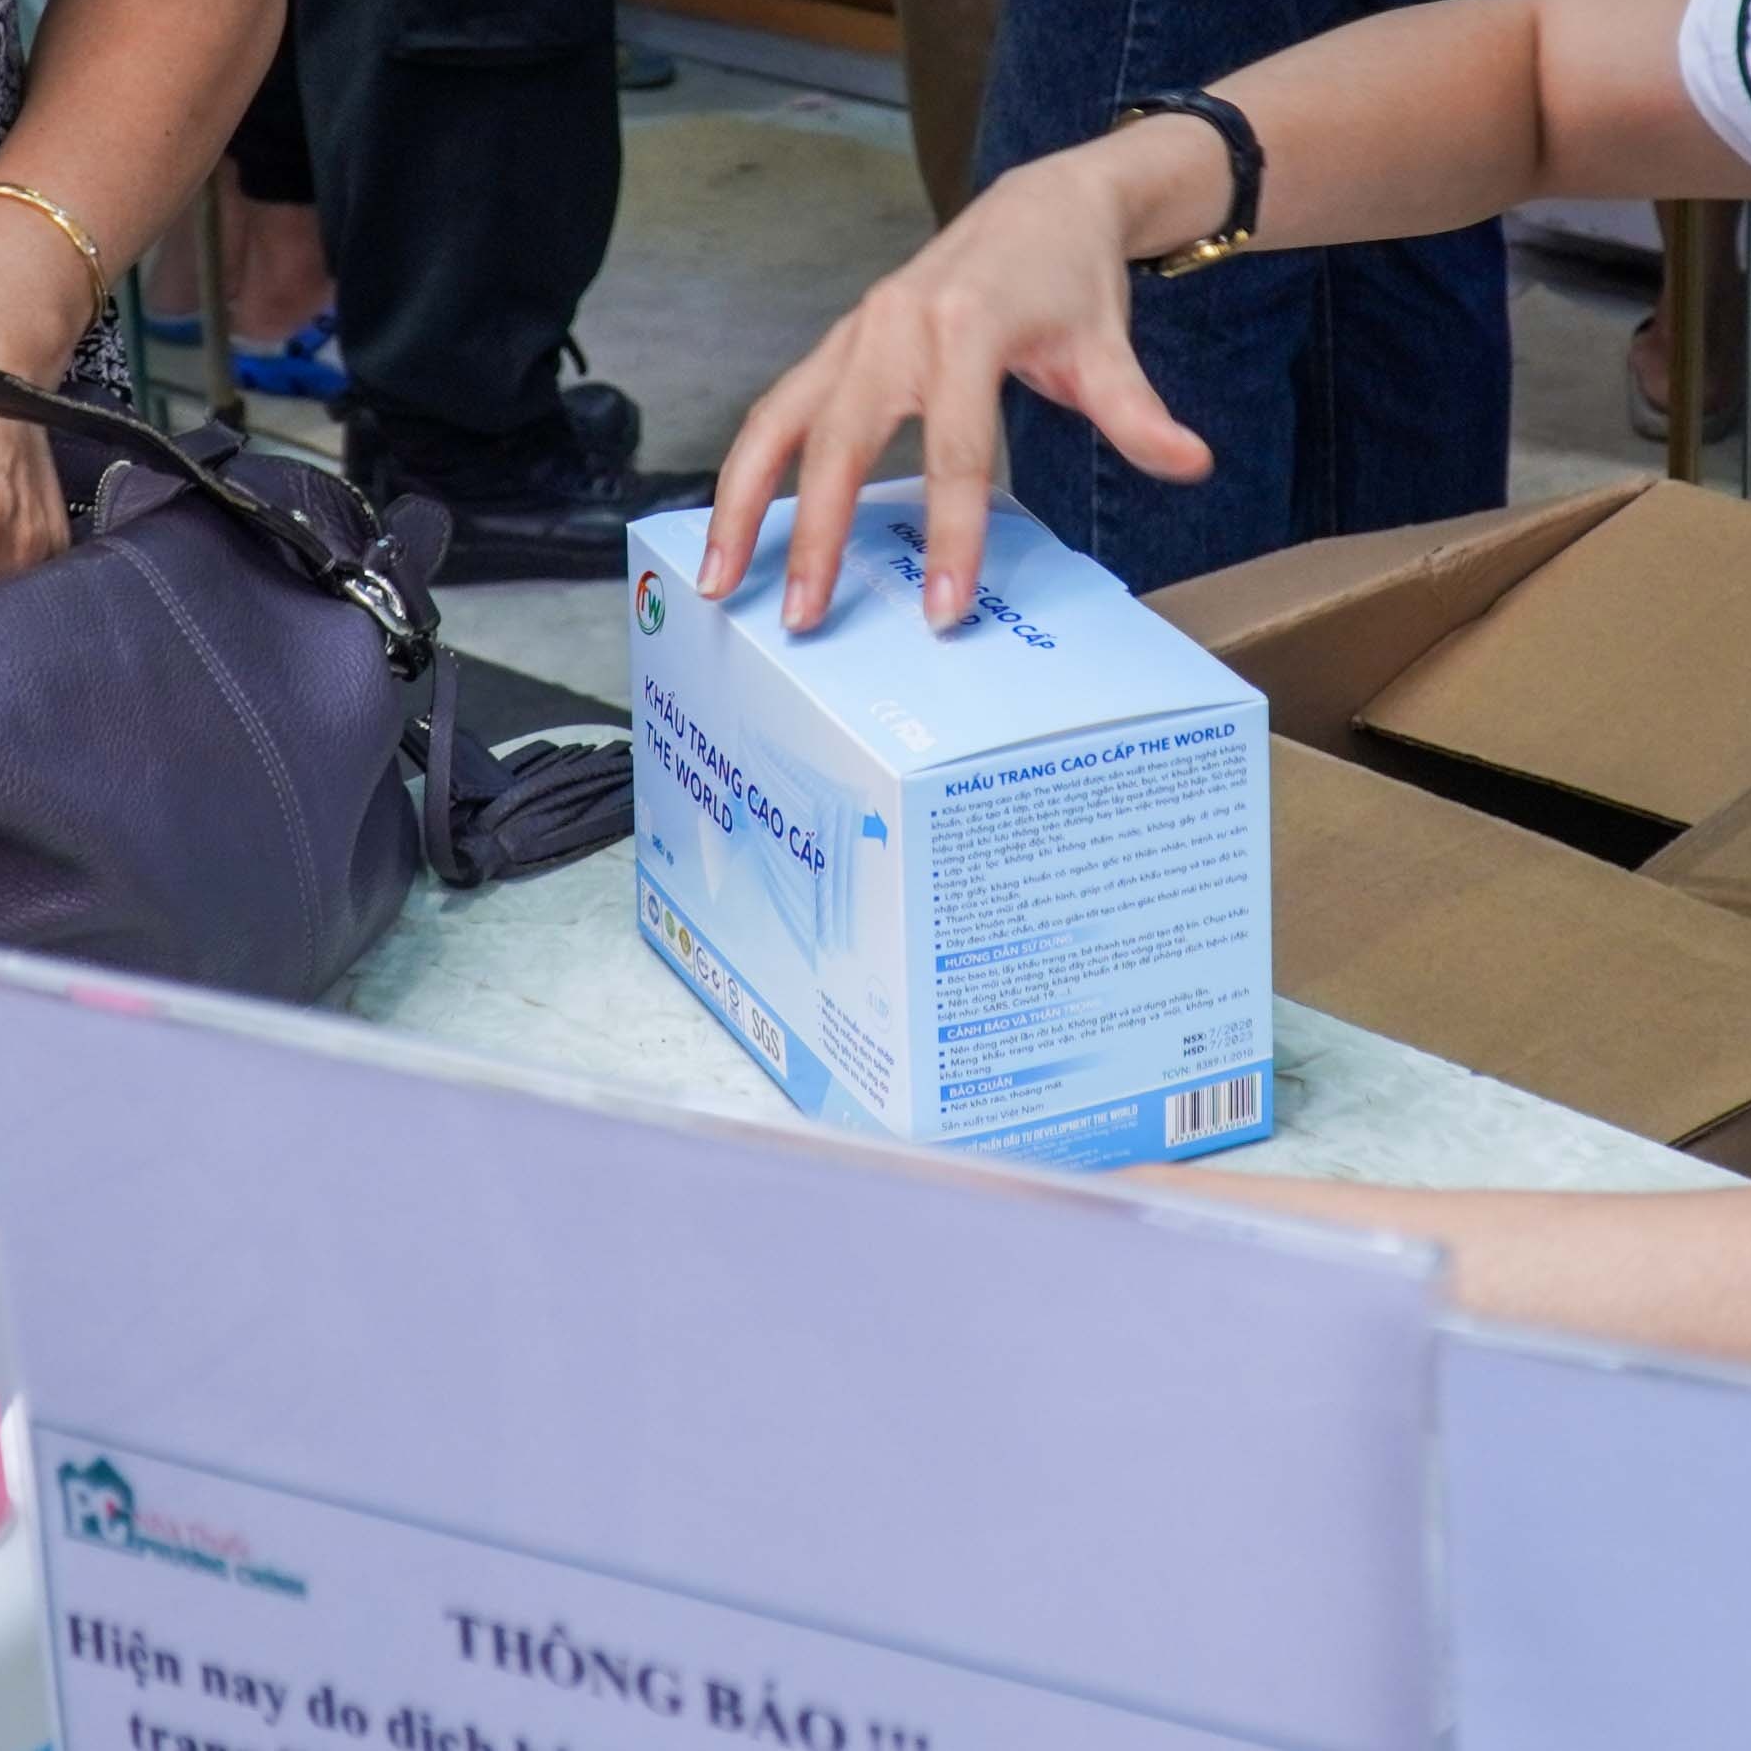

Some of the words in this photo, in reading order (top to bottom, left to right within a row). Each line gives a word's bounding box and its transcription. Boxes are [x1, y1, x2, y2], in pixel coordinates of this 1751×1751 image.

[645, 675, 685, 739] KHẨU
[689, 720, 743, 799] TRANG
[747, 783, 784, 839] CAO
[646, 720, 672, 770] THE
[675, 757, 733, 835] WORLD
[944, 769, 994, 798] KHẨU
[997, 760, 1056, 786] TRANG
[1060, 751, 1097, 773] CAO
[1101, 738, 1135, 764] CẤP
[1138, 736, 1170, 756] THE
[1173, 721, 1234, 748] WORLD
[1034, 783, 1050, 796] The
[751, 1007, 781, 1063] SGS
[949, 1082, 975, 1099] BẢO
[978, 1073, 1012, 1093] QUẢN
[1021, 1100, 1044, 1115] Nam
[68, 1613, 183, 1689] Hiện
[201, 1659, 287, 1726] nay
[307, 1685, 369, 1738] do
[445, 1609, 684, 1718] THÔNG
